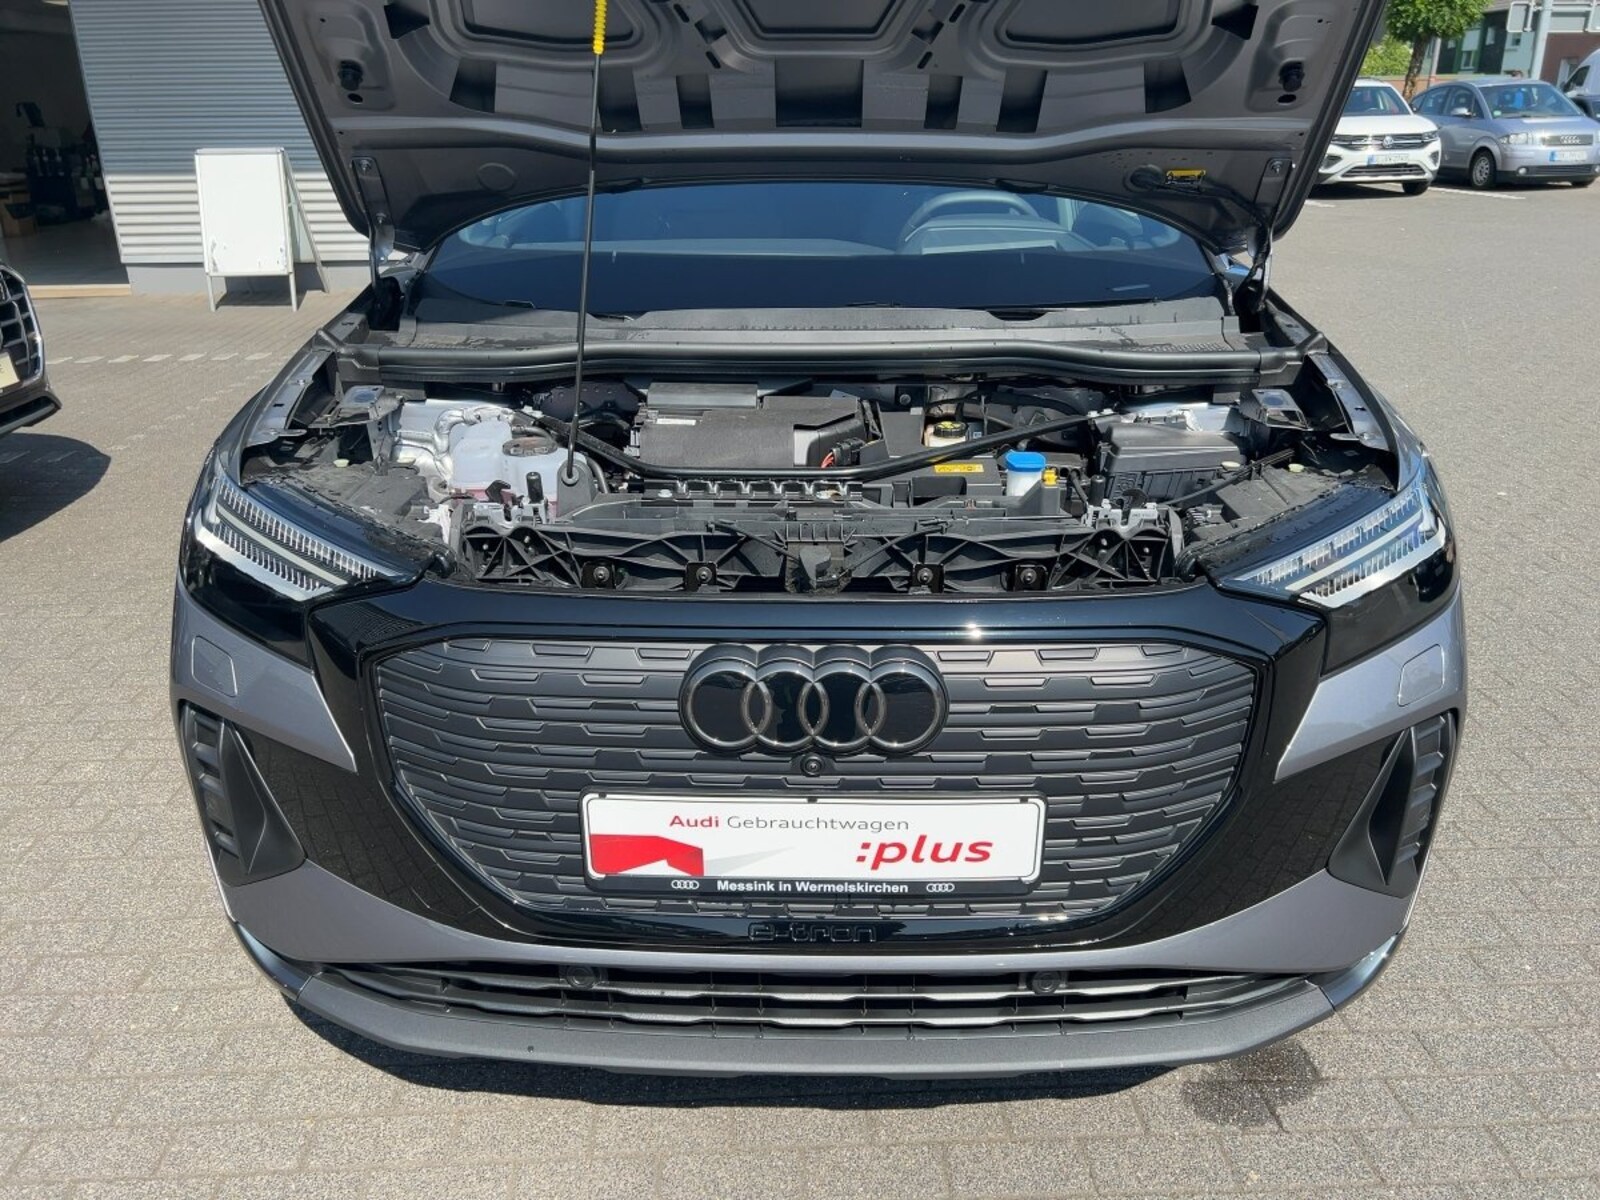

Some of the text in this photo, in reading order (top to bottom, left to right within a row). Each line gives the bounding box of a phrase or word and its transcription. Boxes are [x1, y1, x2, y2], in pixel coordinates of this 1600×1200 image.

[669, 815, 909, 833] Audi Gebrauchtwagen
[716, 880, 909, 894] Messink in Wermelskirchen
[747, 921, 877, 943] e-tron
